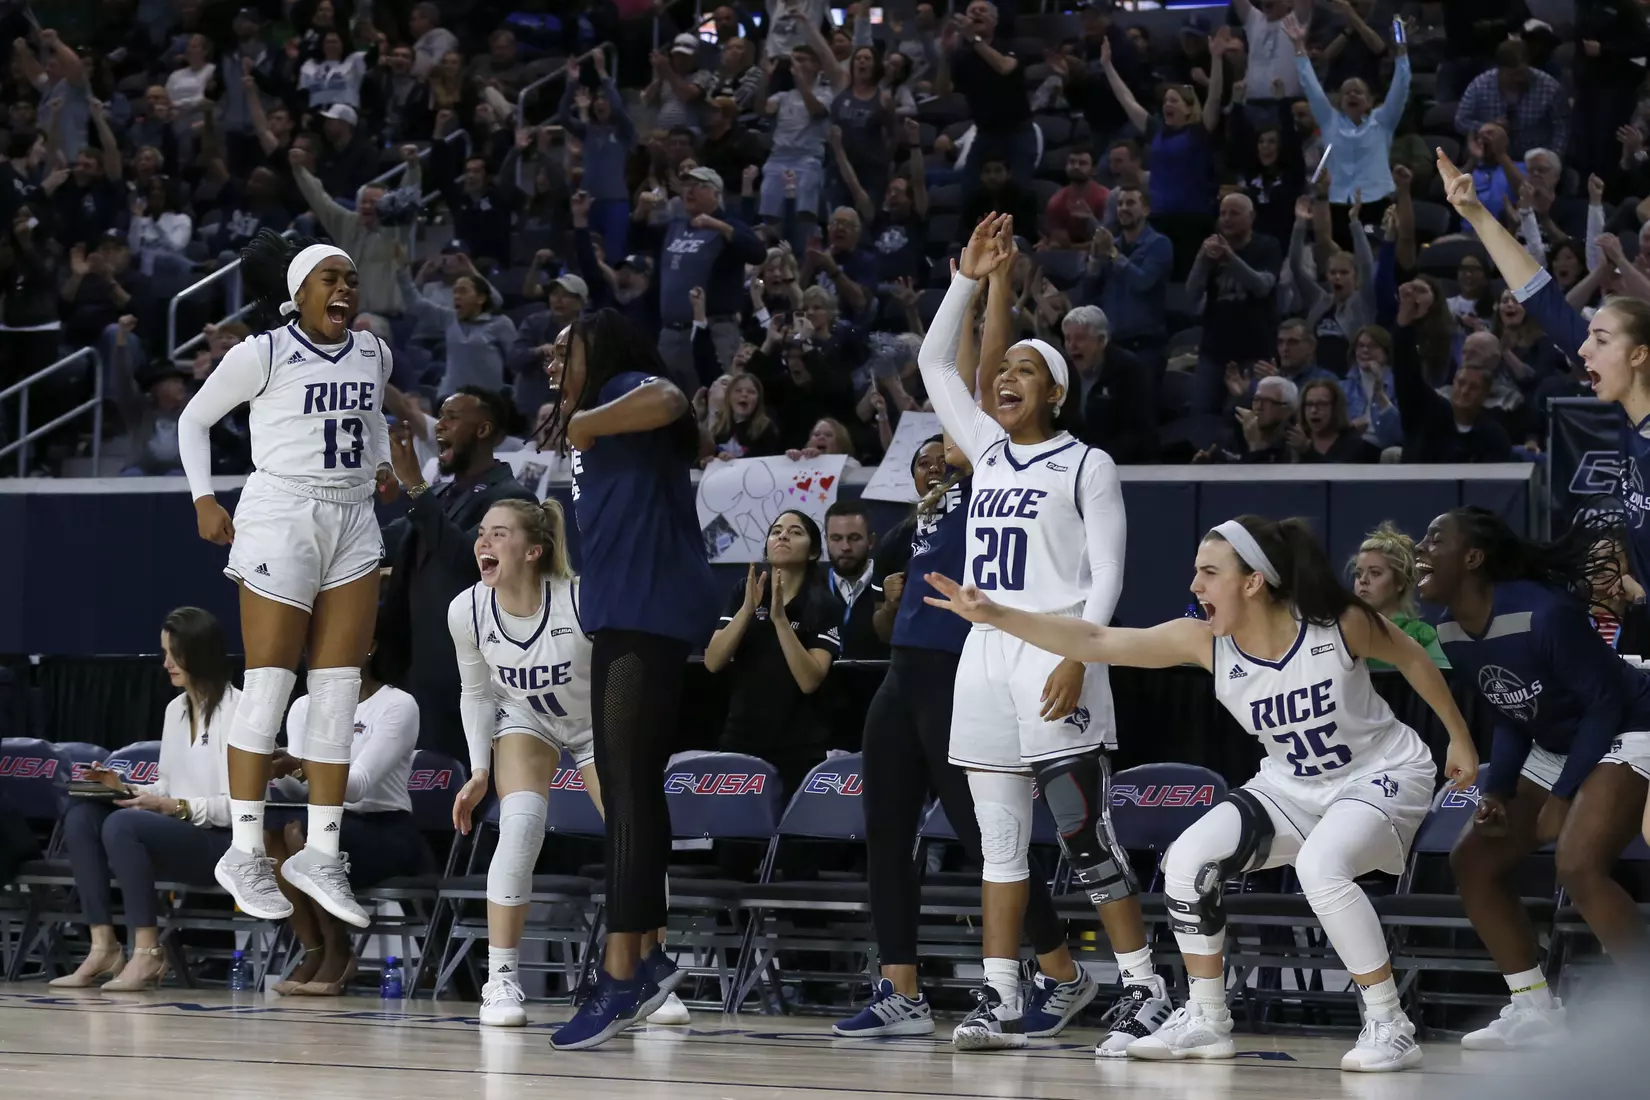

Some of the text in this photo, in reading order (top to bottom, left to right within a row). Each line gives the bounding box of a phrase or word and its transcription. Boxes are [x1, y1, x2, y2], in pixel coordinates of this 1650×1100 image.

[303, 382, 375, 414] RICE
[324, 417, 364, 469] 13
[970, 488, 1048, 519] RICE
[973, 527, 1028, 591] 20
[496, 660, 572, 690] RICE
[526, 692, 568, 717] 11
[1249, 678, 1337, 731] RICE
[1502, 680, 1543, 704] OWLS
[1272, 721, 1353, 777] 25
